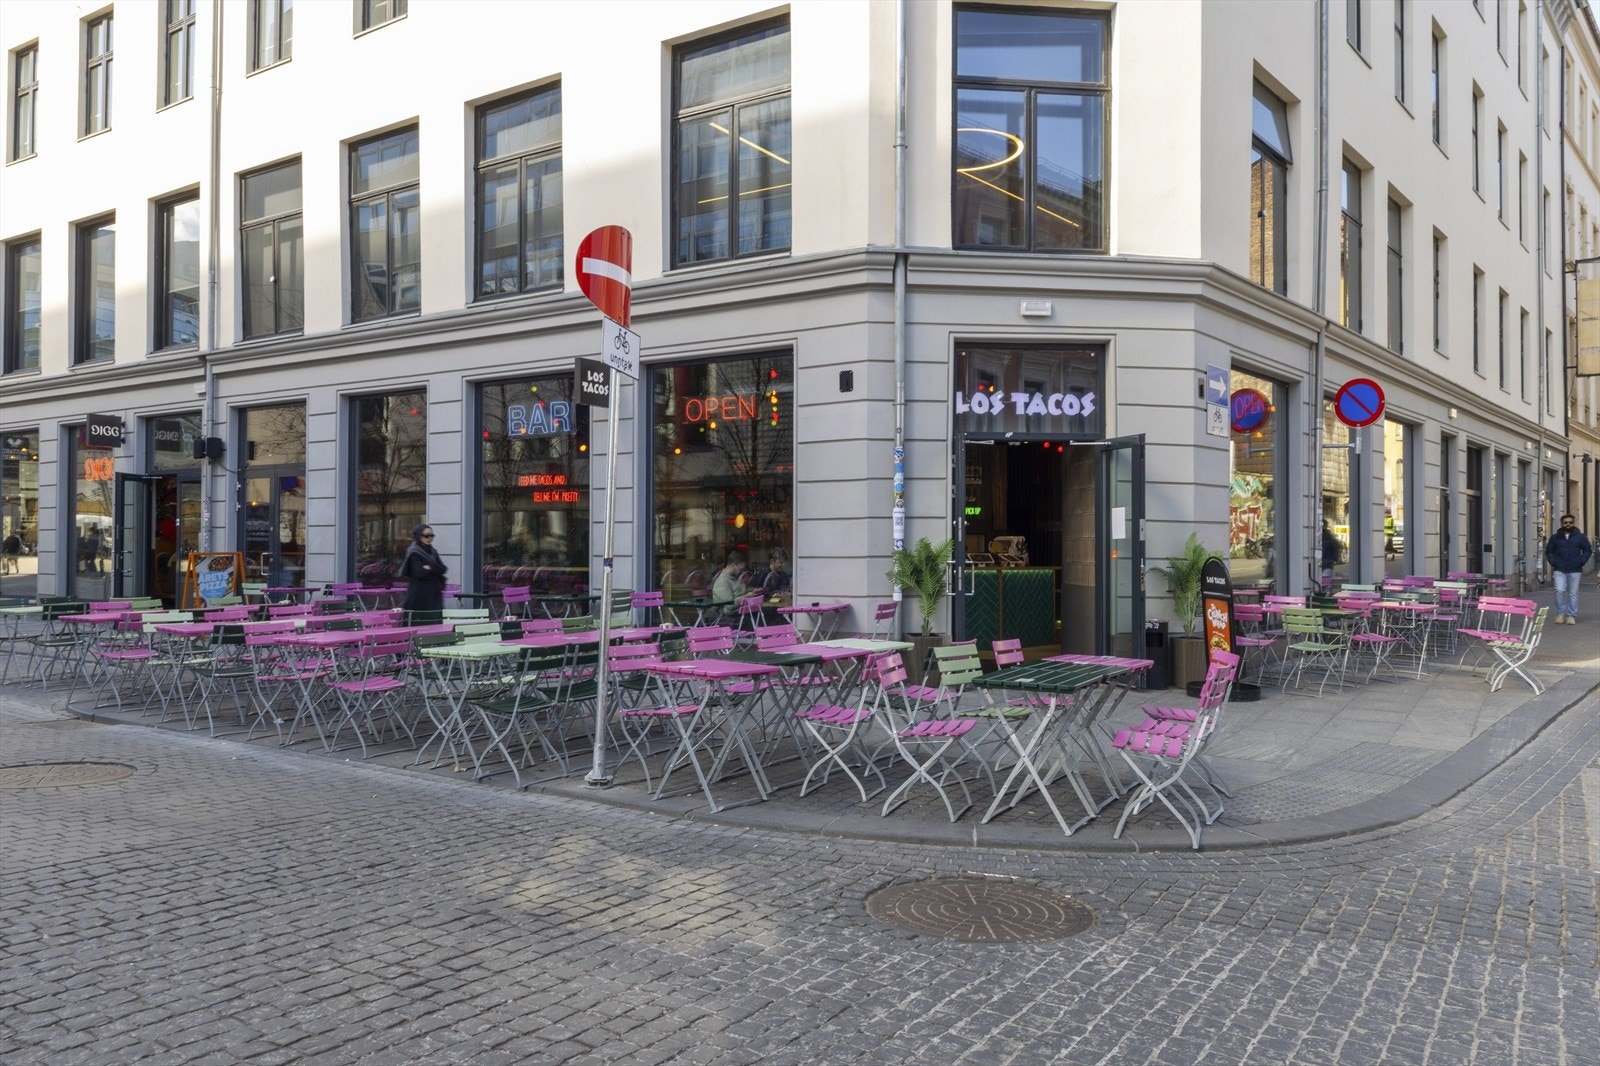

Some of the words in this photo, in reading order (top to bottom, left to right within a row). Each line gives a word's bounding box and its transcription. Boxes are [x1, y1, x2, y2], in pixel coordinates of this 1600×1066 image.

[587, 370, 604, 383] LOS
[582, 381, 609, 396] TACOS
[685, 394, 755, 422] OPEN
[955, 390, 1005, 416] LOS
[1010, 391, 1096, 417] TACOS
[508, 400, 571, 436] BAR
[91, 424, 120, 437] DIGG
[529, 474, 538, 486] ME
[537, 474, 553, 486] TACOS
[553, 474, 566, 485] AND
[543, 491, 551, 502] ME
[561, 491, 579, 502] PRETTY
[199, 580, 228, 592] PIZZA
